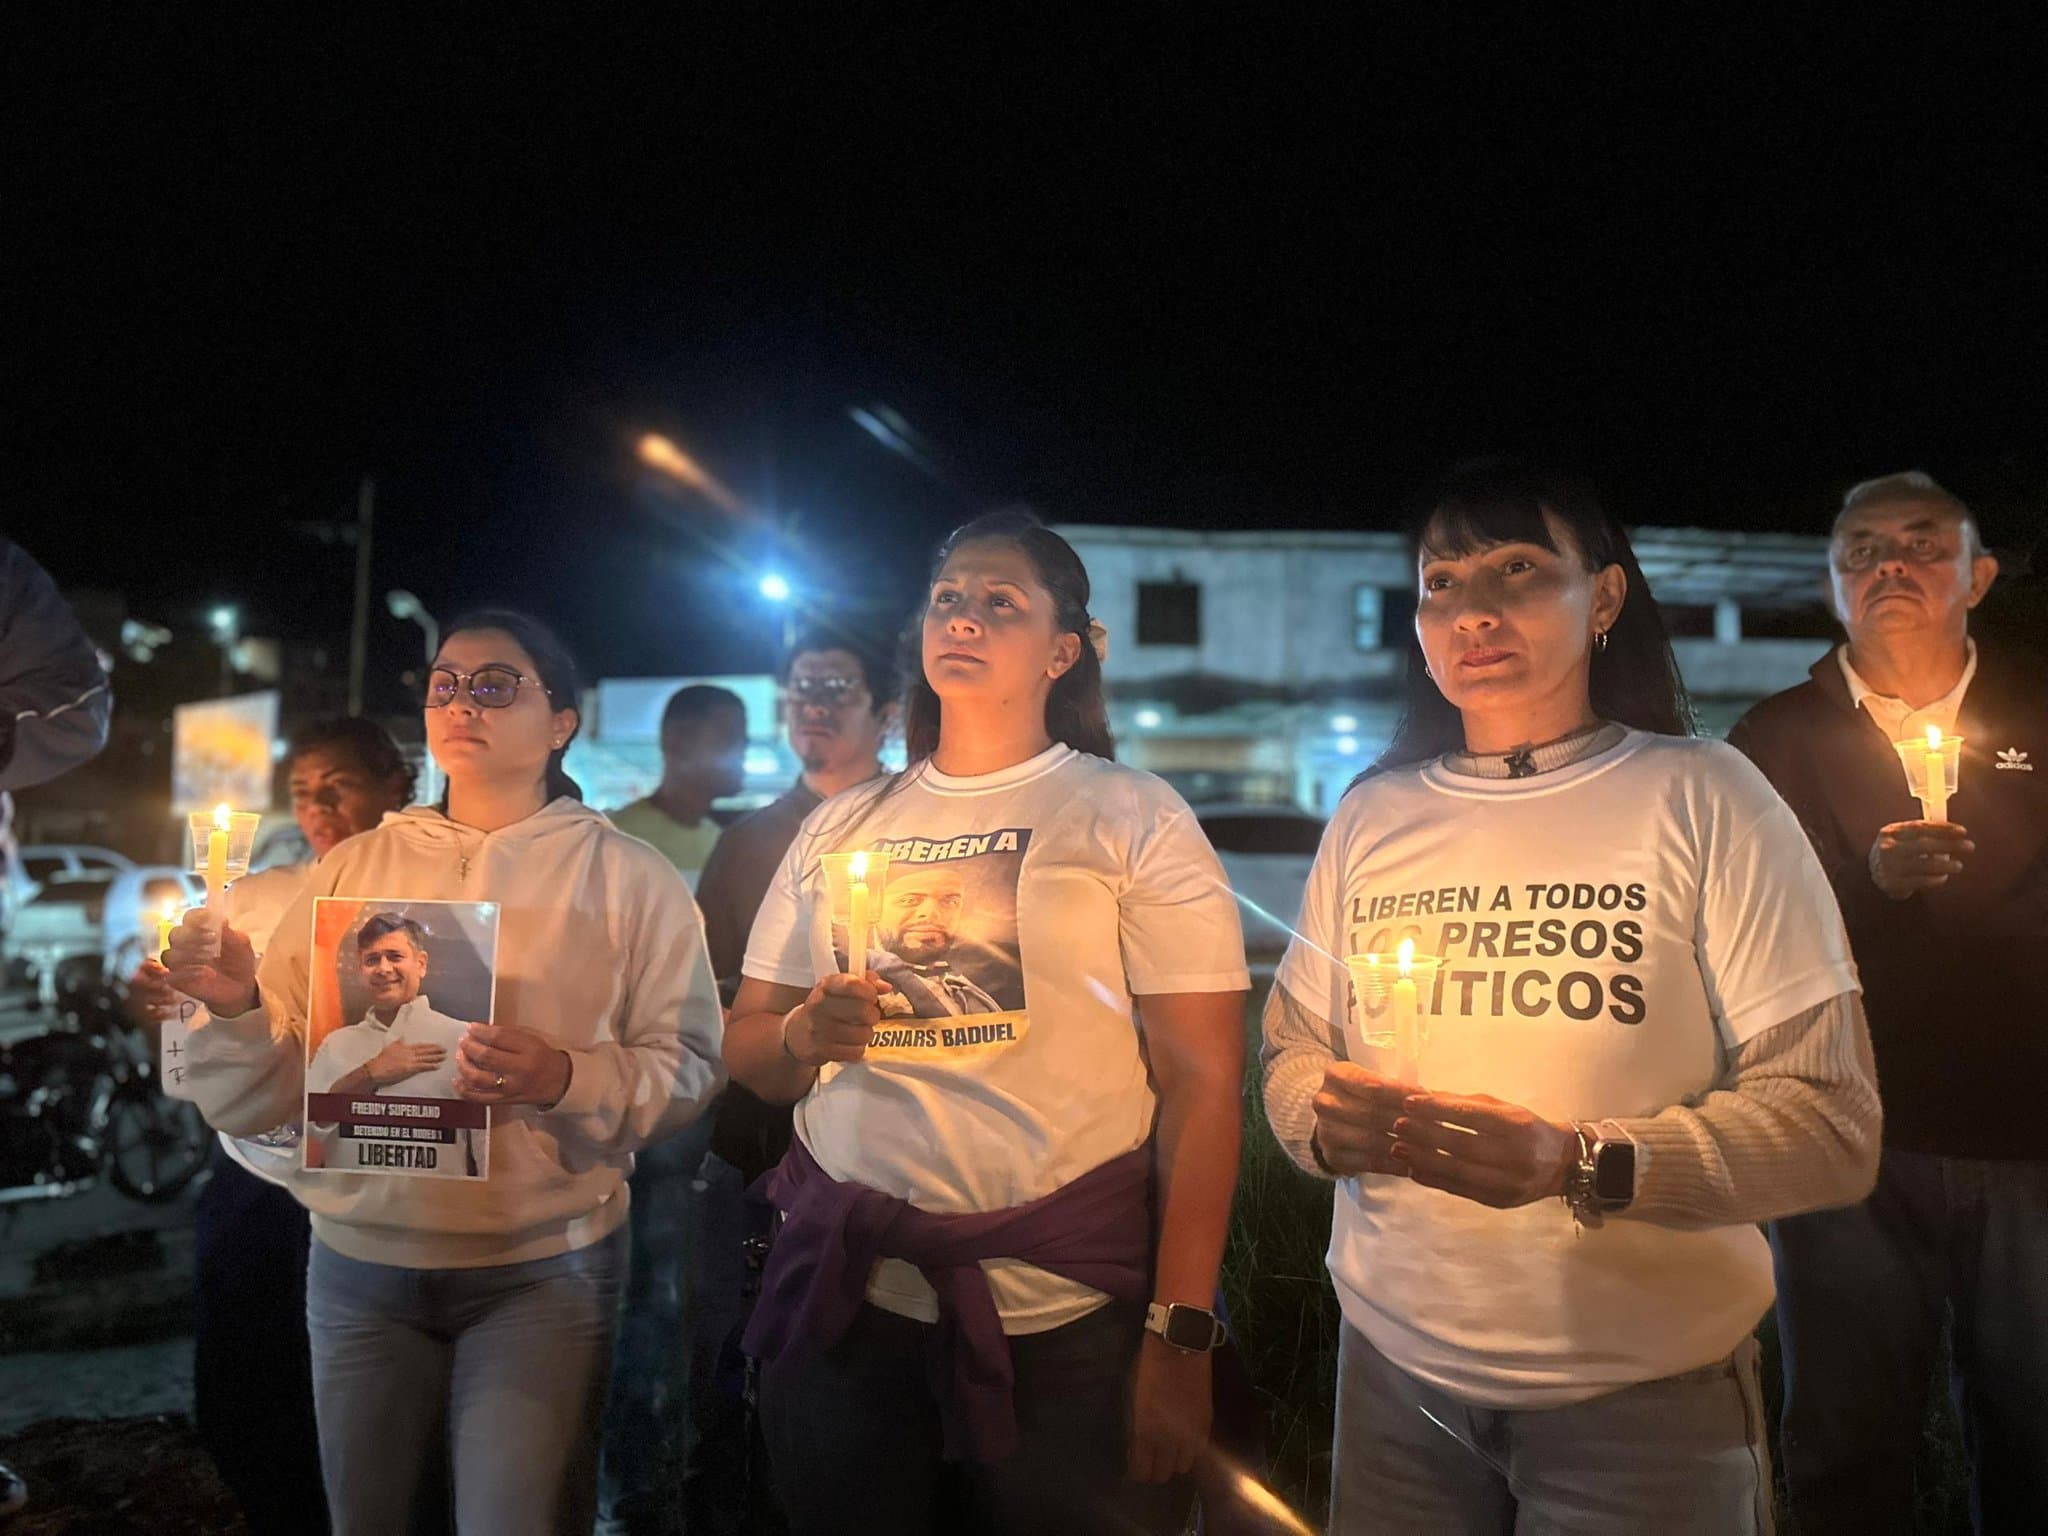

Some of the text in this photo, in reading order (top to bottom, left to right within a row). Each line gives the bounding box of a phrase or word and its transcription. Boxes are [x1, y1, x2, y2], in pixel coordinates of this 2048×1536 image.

[1995, 762, 2033, 771] adidas
[994, 831, 1018, 851] A
[1352, 883, 1647, 923] LIBEREN A TODOS
[1438, 919, 1643, 963] PRESOS
[868, 1023, 1017, 1048] OSNARS BADUEL
[352, 1101, 386, 1115] FREDDY
[358, 1143, 437, 1168] LIBERTAD
